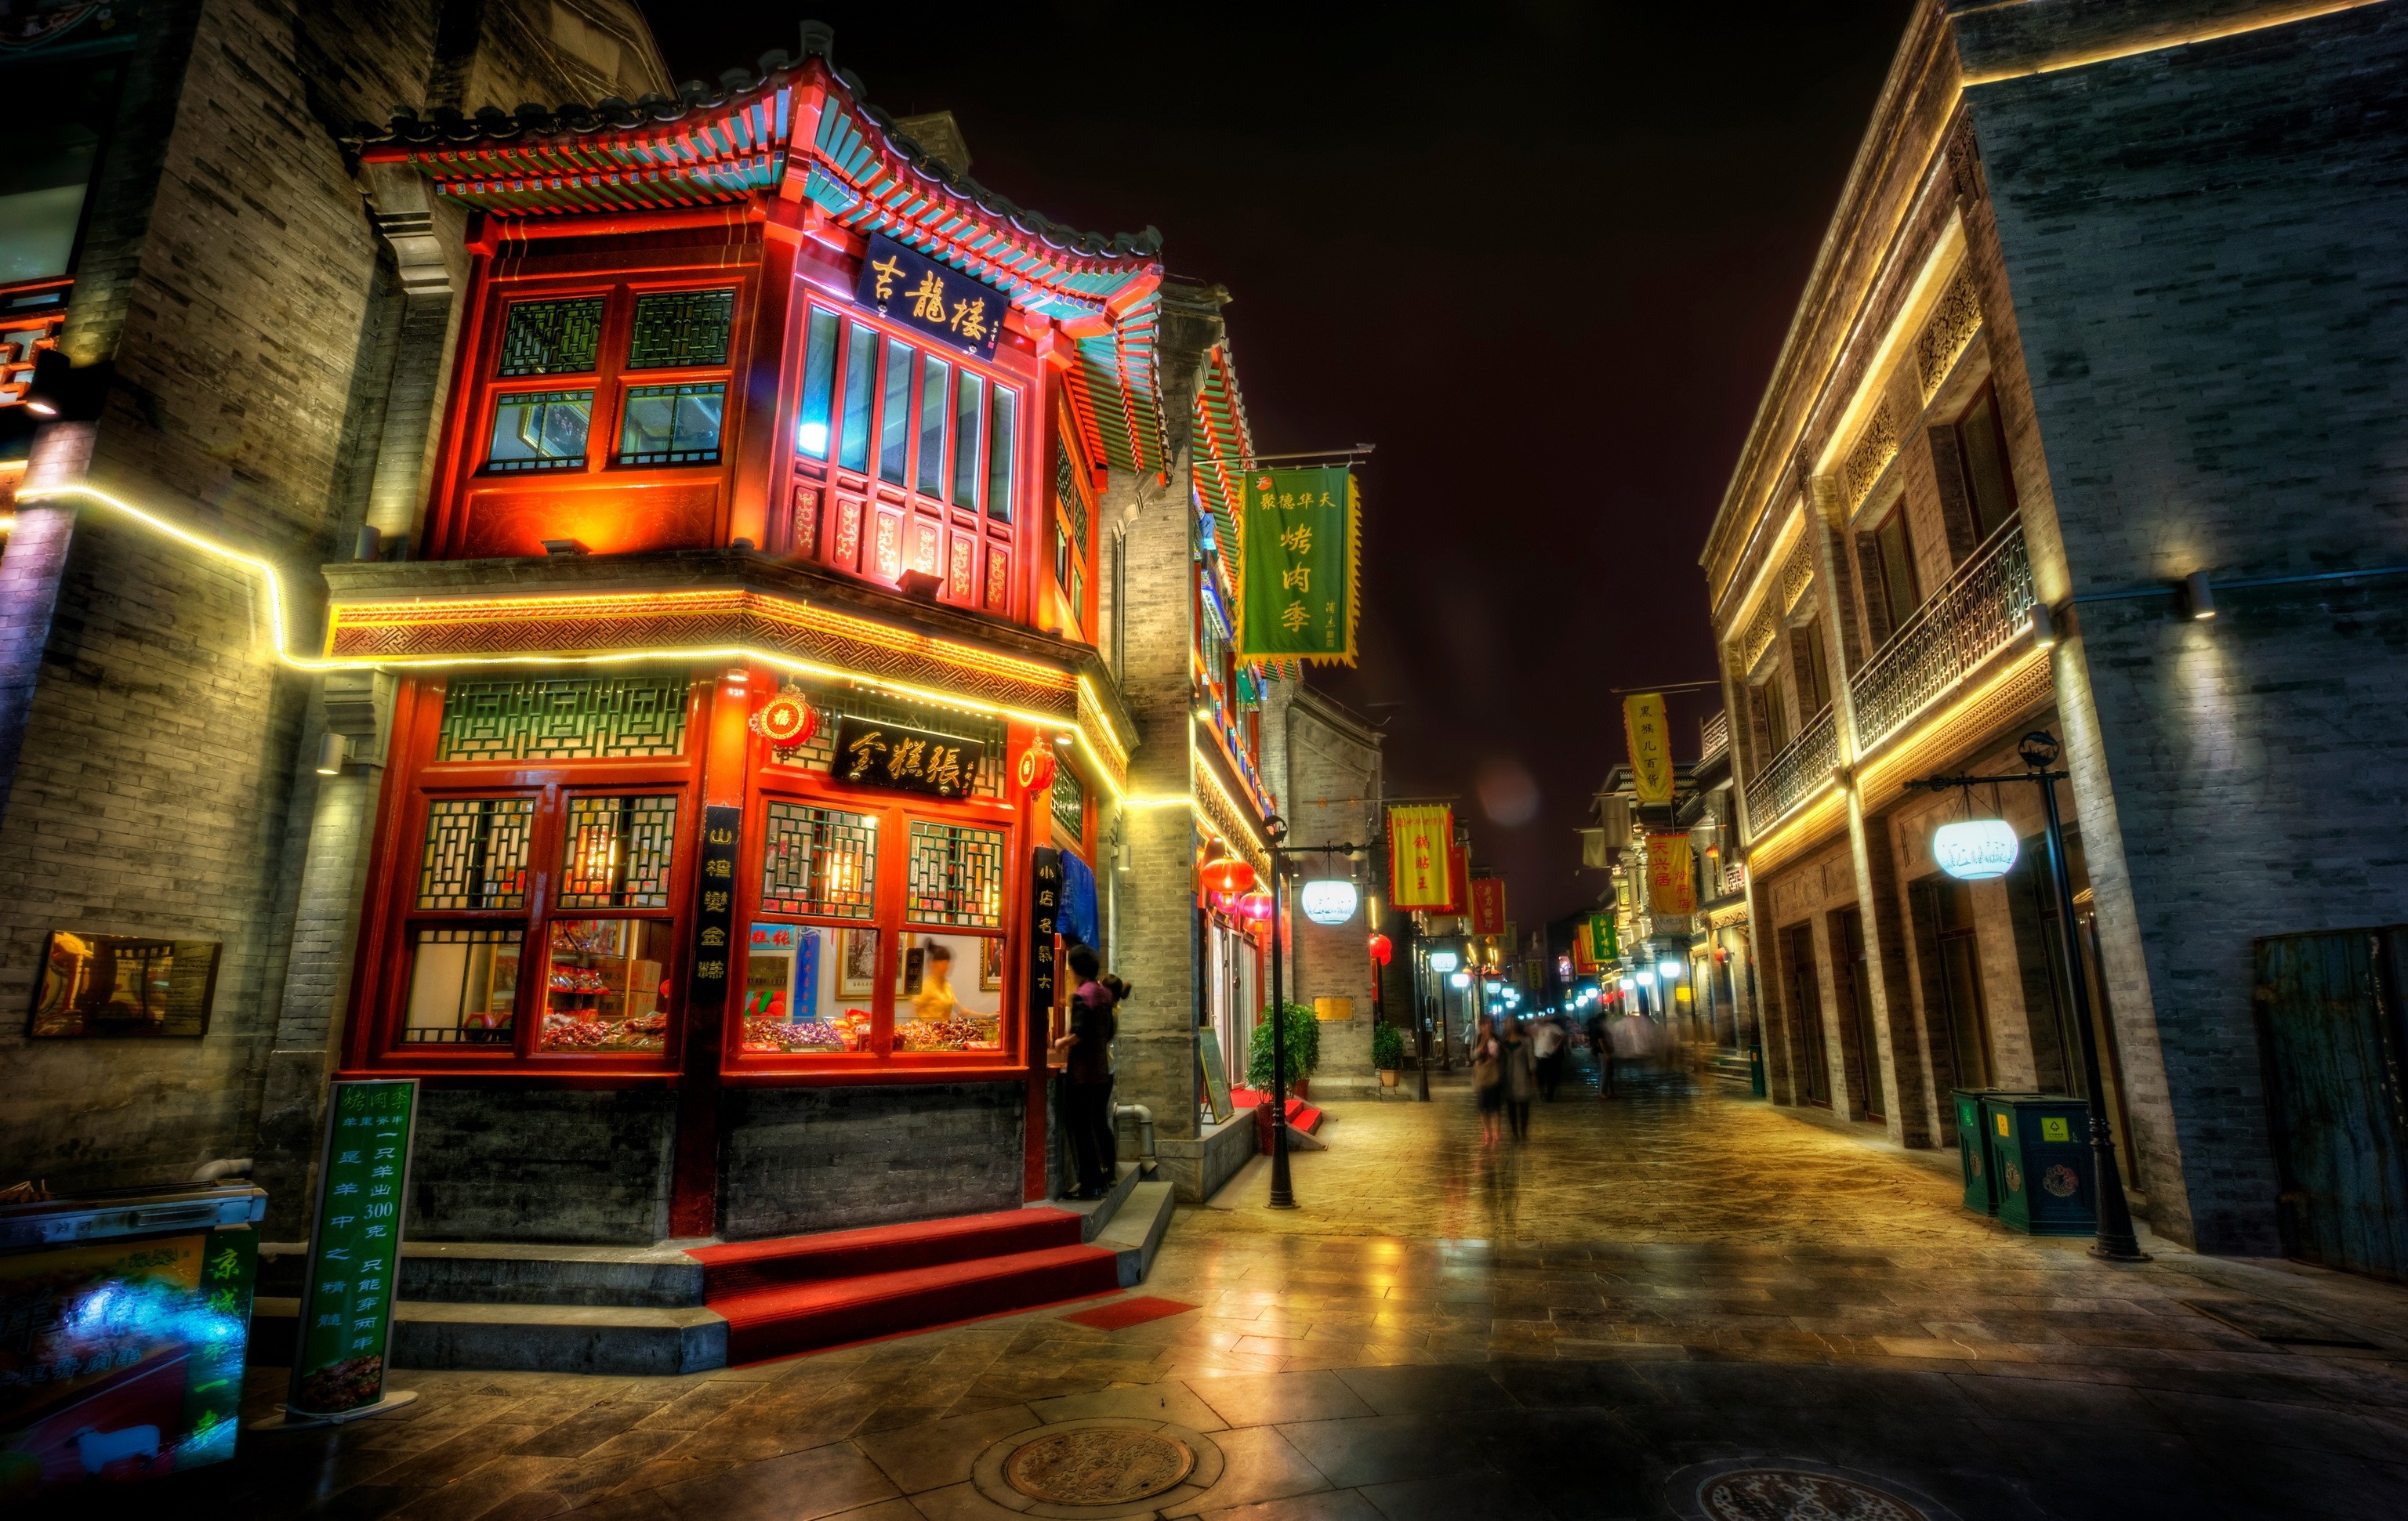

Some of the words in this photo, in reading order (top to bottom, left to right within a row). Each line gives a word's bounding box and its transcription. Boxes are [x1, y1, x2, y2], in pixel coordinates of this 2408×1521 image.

[1280, 523, 1312, 632] 烤肉季
[1639, 705, 1659, 788] 黑猴儿百货
[1652, 842, 1671, 886] 天兴居
[1675, 870, 1692, 909] 炒肝店
[342, 1085, 408, 1112] 烤肉季
[317, 1150, 362, 1328] 是羊中之精髓
